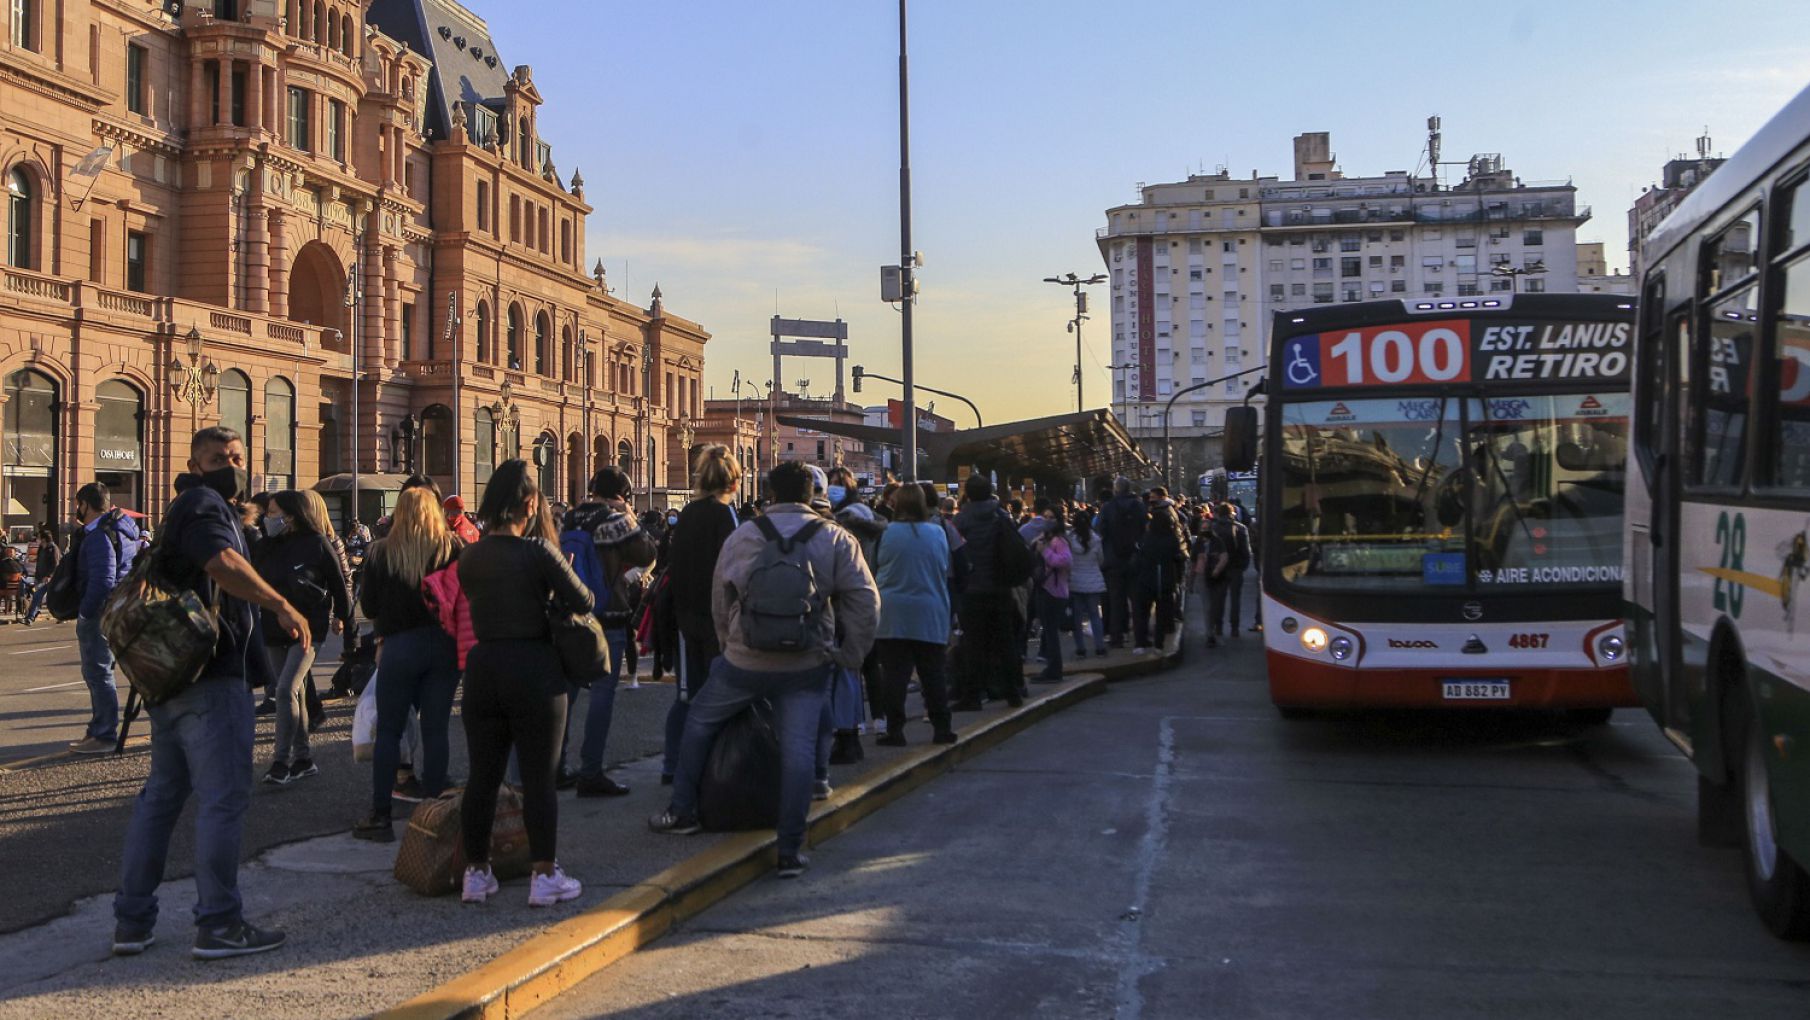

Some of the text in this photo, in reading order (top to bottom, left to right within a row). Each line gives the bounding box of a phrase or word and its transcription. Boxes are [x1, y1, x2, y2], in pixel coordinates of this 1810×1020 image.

[1480, 323, 1629, 351] EST. LANUS
[1331, 329, 1464, 383] 100
[1485, 352, 1627, 379] RETIRO
[1496, 569, 1528, 583] AIRE
[1713, 511, 1746, 620] 28
[1508, 633, 1549, 649] 4867
[1447, 685, 1507, 696] AD 882 PY
